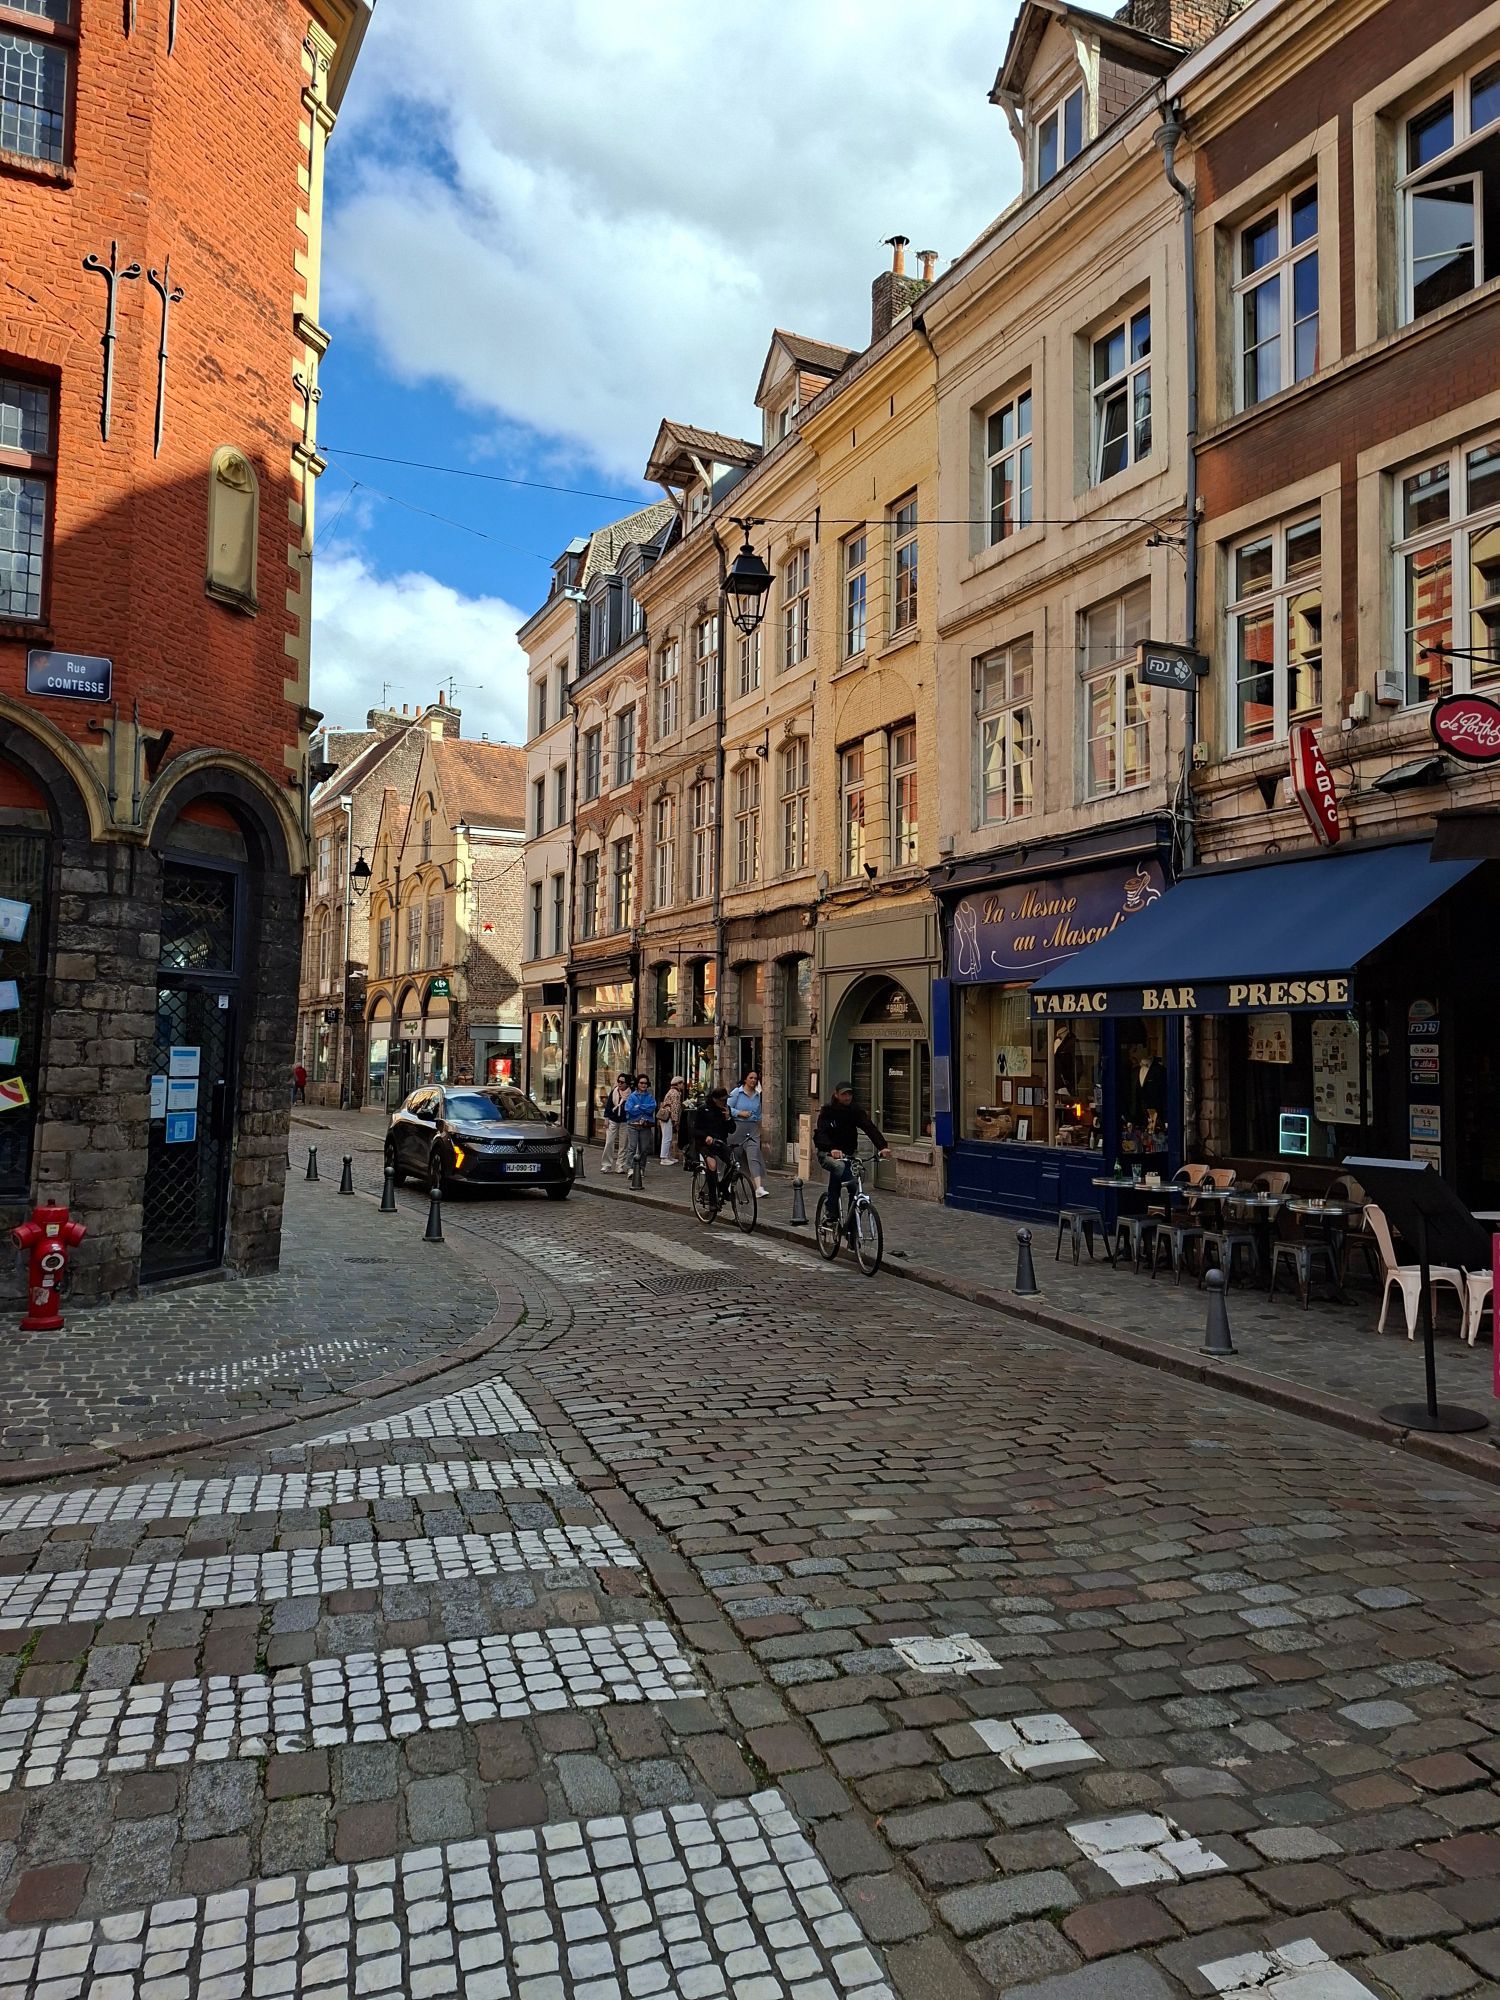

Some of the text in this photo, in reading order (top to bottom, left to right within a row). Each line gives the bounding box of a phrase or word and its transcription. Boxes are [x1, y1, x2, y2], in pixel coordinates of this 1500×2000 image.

[67, 661, 86, 674] Rue
[1150, 659, 1170, 673] FDJ
[47, 676, 105, 693] COMTESSE
[1440, 711, 1464, 731] Le
[1310, 745, 1338, 822] TABAC
[981, 889, 1077, 925] La Mesure
[1013, 911, 1125, 952] au Mascul
[1033, 978, 1349, 1013] TABAC BAR PRESSE
[1410, 1023, 1428, 1033] FDJ
